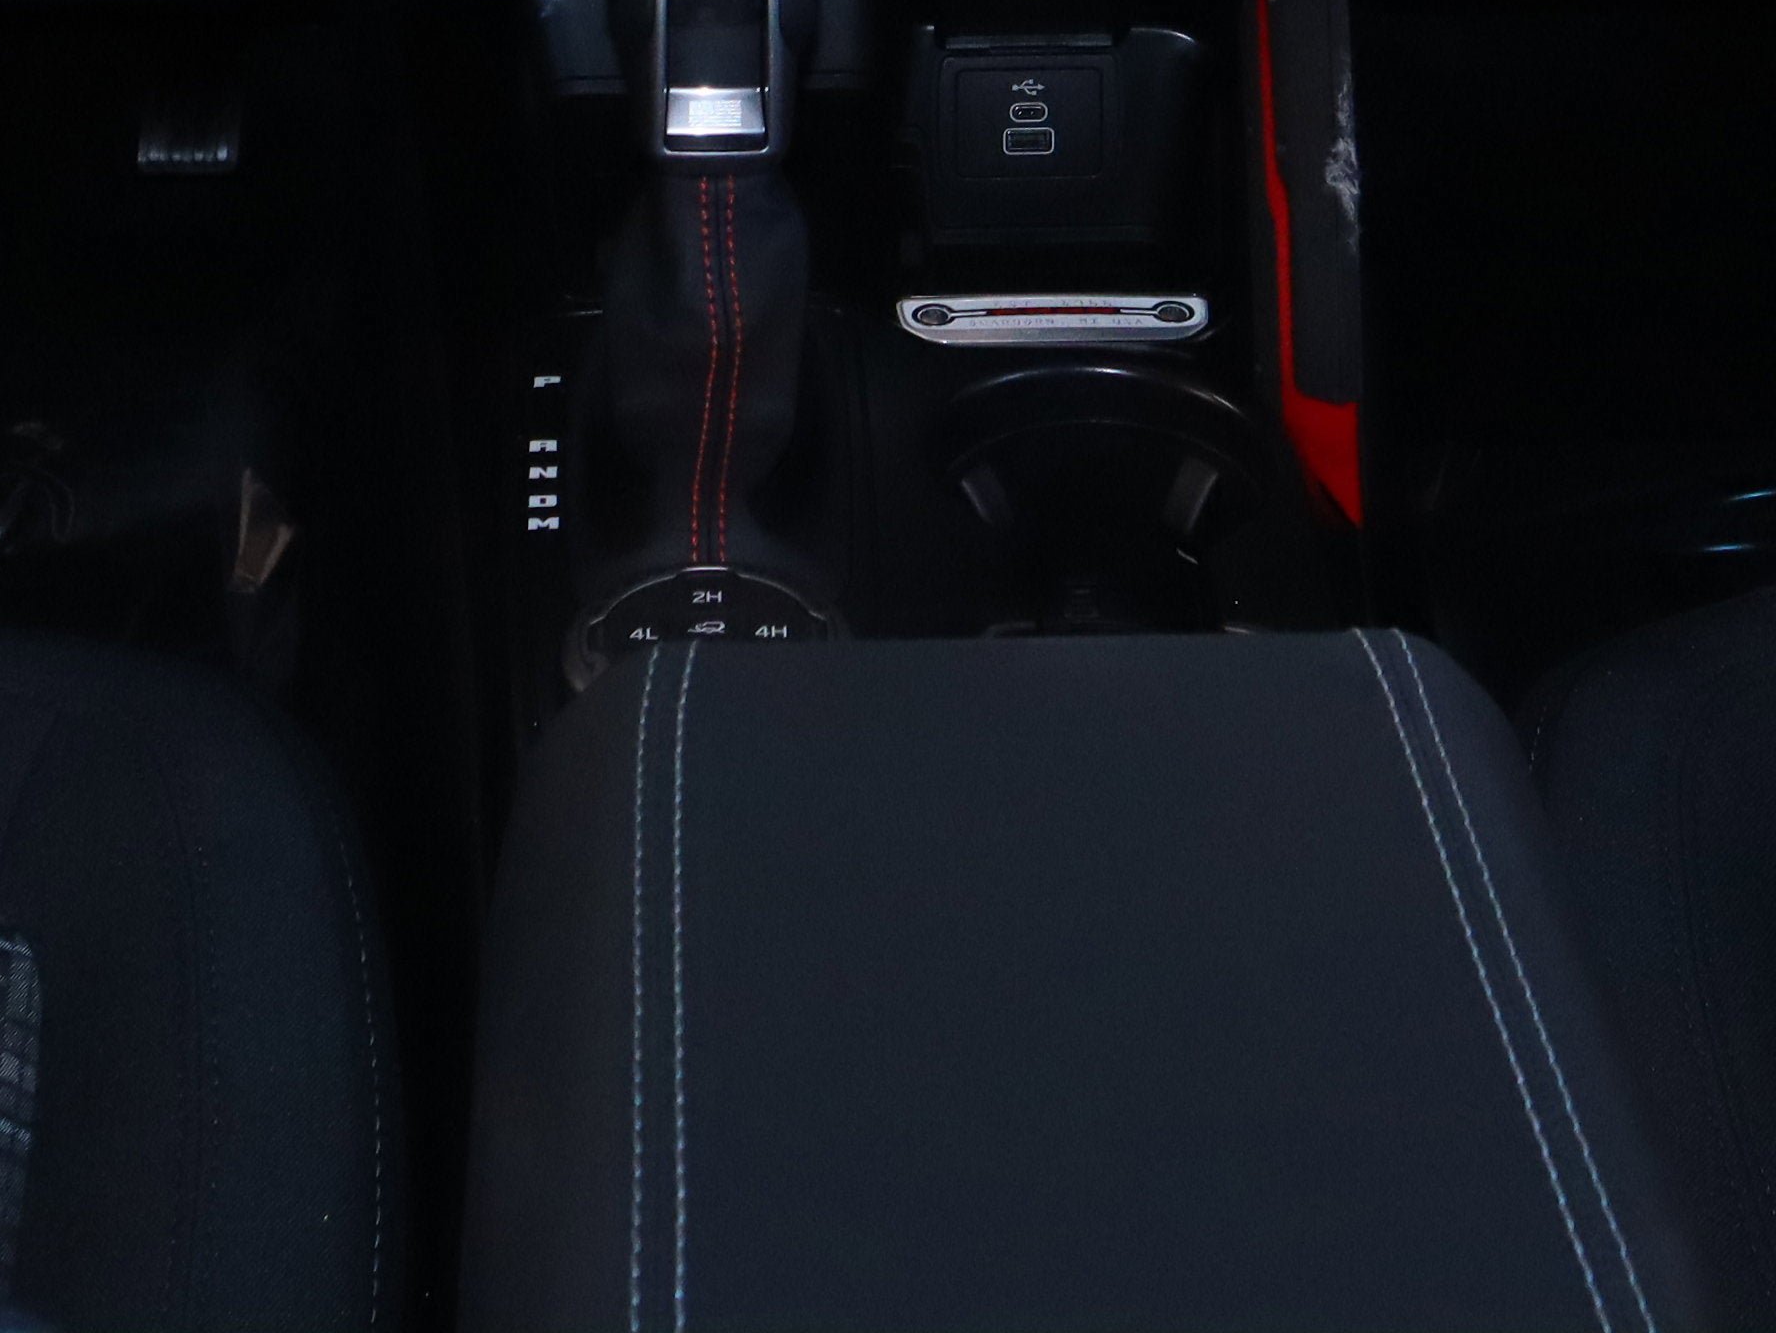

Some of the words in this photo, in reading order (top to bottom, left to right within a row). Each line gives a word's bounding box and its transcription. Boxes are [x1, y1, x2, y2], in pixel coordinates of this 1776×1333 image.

[533, 375, 561, 388] P
[528, 466, 558, 479] N
[528, 494, 557, 508] D
[527, 516, 560, 531] M
[692, 590, 723, 604] 2H
[628, 627, 659, 641] 4L
[754, 625, 788, 639] 4H
